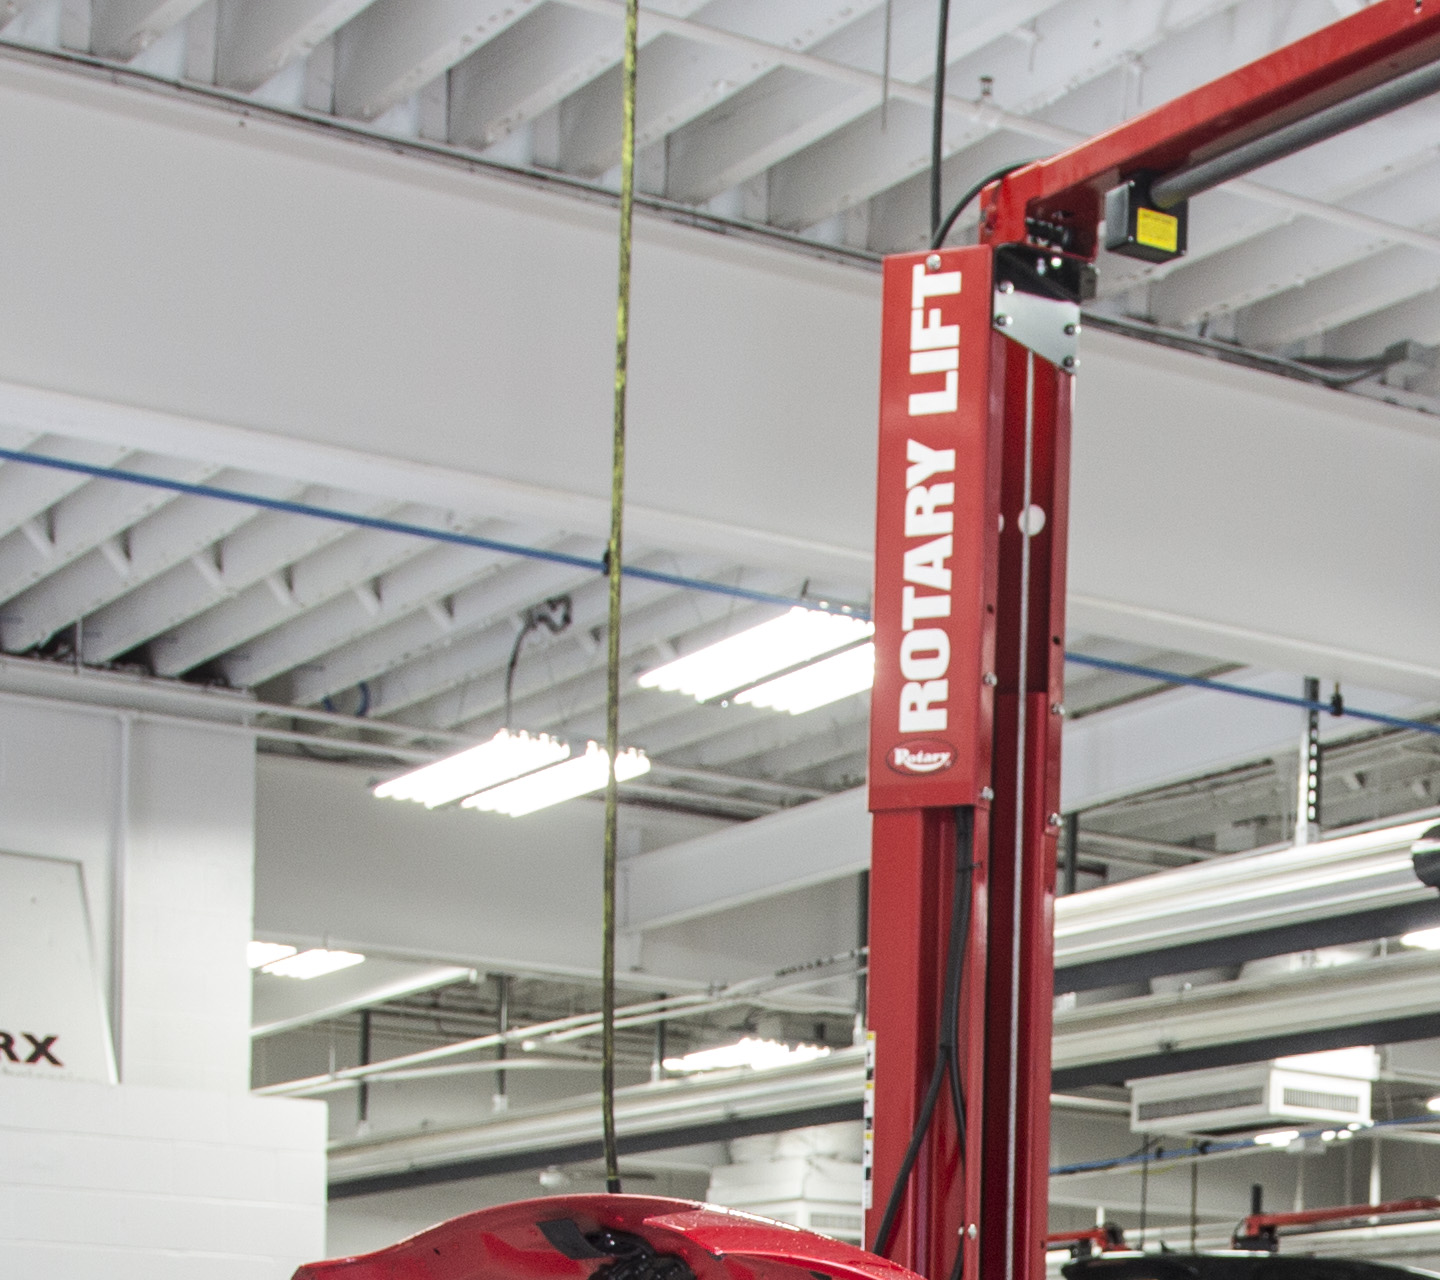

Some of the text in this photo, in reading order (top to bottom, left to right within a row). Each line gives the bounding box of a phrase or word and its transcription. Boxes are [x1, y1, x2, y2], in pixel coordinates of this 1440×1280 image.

[899, 264, 962, 733] ROTARY LIFT
[893, 747, 952, 773] Rotary
